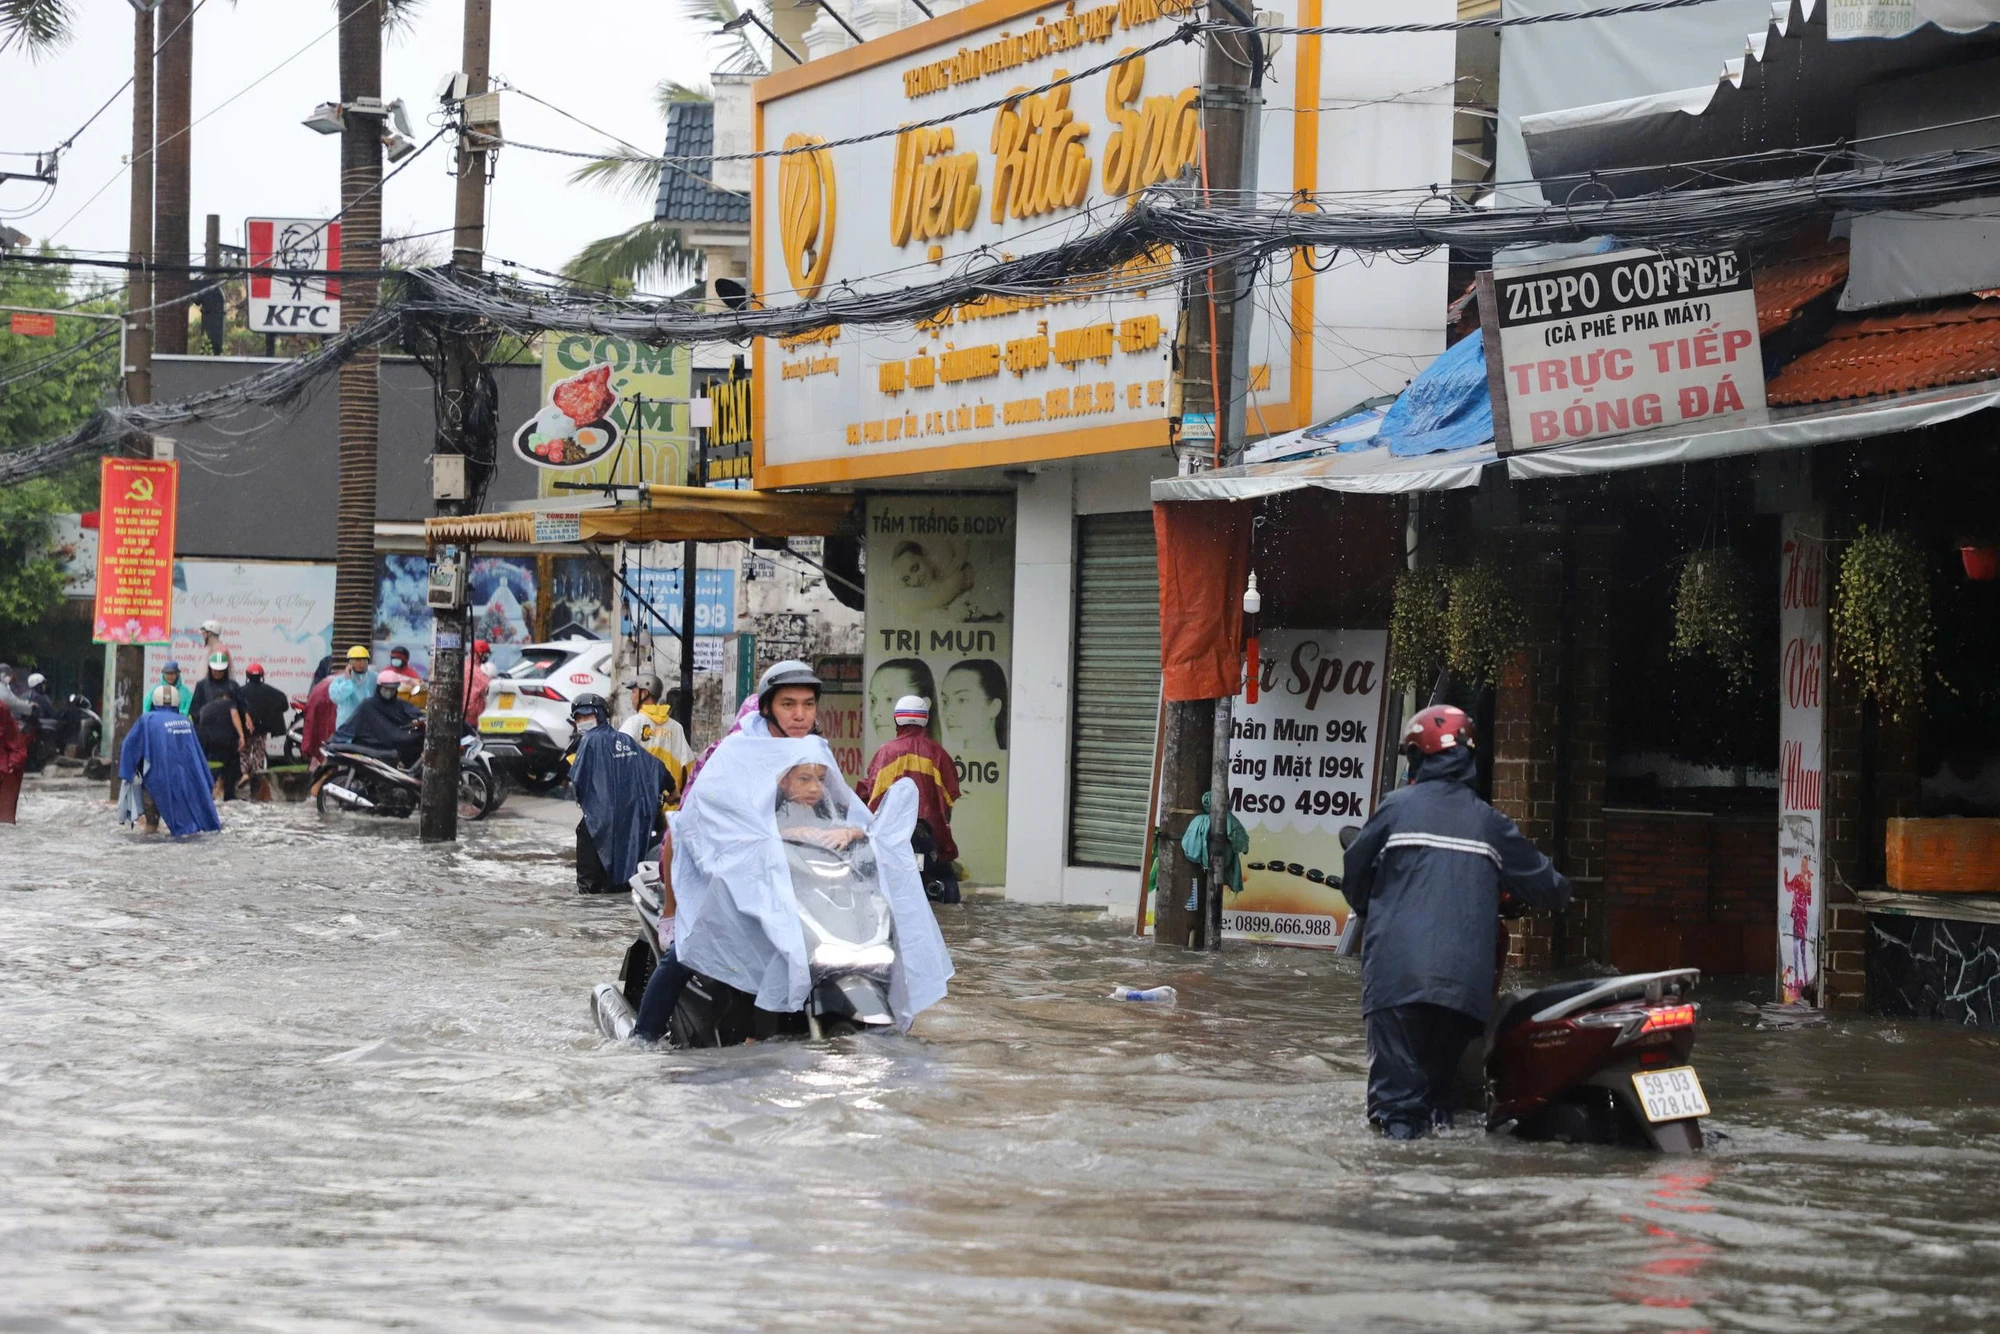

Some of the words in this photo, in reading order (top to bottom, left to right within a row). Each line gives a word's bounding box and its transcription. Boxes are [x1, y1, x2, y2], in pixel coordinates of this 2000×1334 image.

[890, 122, 981, 265] Viện
[1102, 46, 1198, 212] Spa
[1506, 271, 1600, 320] ZIPPO
[1611, 250, 1740, 303] COFFEE
[263, 305, 330, 327] KFC
[1545, 321, 1576, 347] (CÀ
[1581, 315, 1617, 339] PHÊ
[1622, 311, 1660, 333] PHA
[1664, 302, 1711, 327] MÁY)
[1509, 348, 1634, 396] TRỰC
[1649, 322, 1752, 374] TIẾP
[1530, 393, 1663, 444] BÓNG
[1677, 374, 1744, 420] ĐÁ
[872, 507, 904, 534] TẮM
[963, 516, 1008, 534] BODY
[880, 629, 921, 656] TRỊ
[1286, 640, 1377, 711] Spa
[1230, 717, 1267, 741] hân
[1273, 718, 1319, 748] Mụn
[1326, 719, 1368, 743] 99k
[1273, 755, 1313, 783] Mặt
[1294, 790, 1364, 818] 499k
[1235, 915, 1331, 936] 0899.666.988
[1649, 1092, 1703, 1117] 028.44
